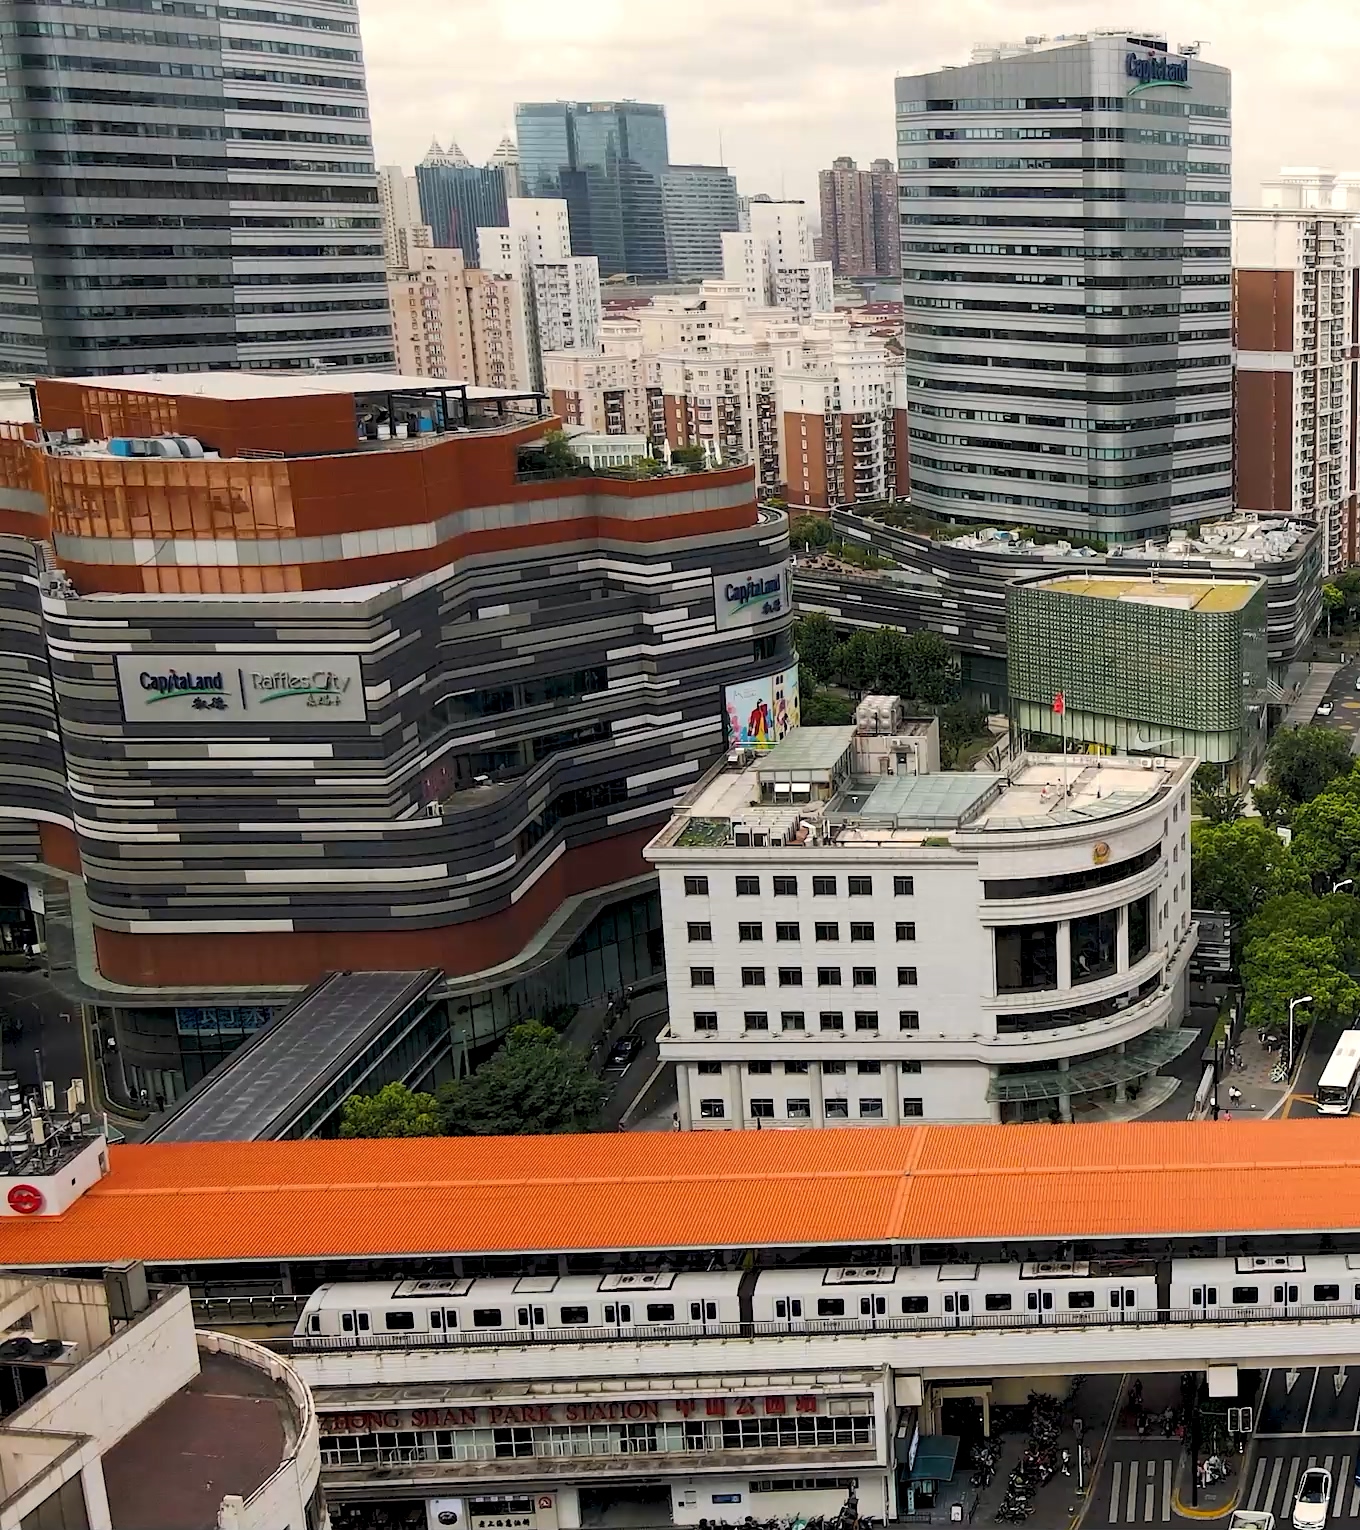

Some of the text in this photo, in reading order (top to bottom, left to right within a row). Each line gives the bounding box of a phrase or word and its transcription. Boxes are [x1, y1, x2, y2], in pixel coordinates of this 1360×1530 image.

[1126, 51, 1188, 83] CapitaLand
[725, 574, 781, 604] CapitaLand
[140, 669, 223, 693] CapitaLand
[250, 670, 351, 692] Raffles City
[318, 1411, 400, 1430] ZHONG
[411, 1407, 477, 1427] SHAN
[489, 1404, 556, 1424] PARK
[566, 1401, 660, 1421] STATION
